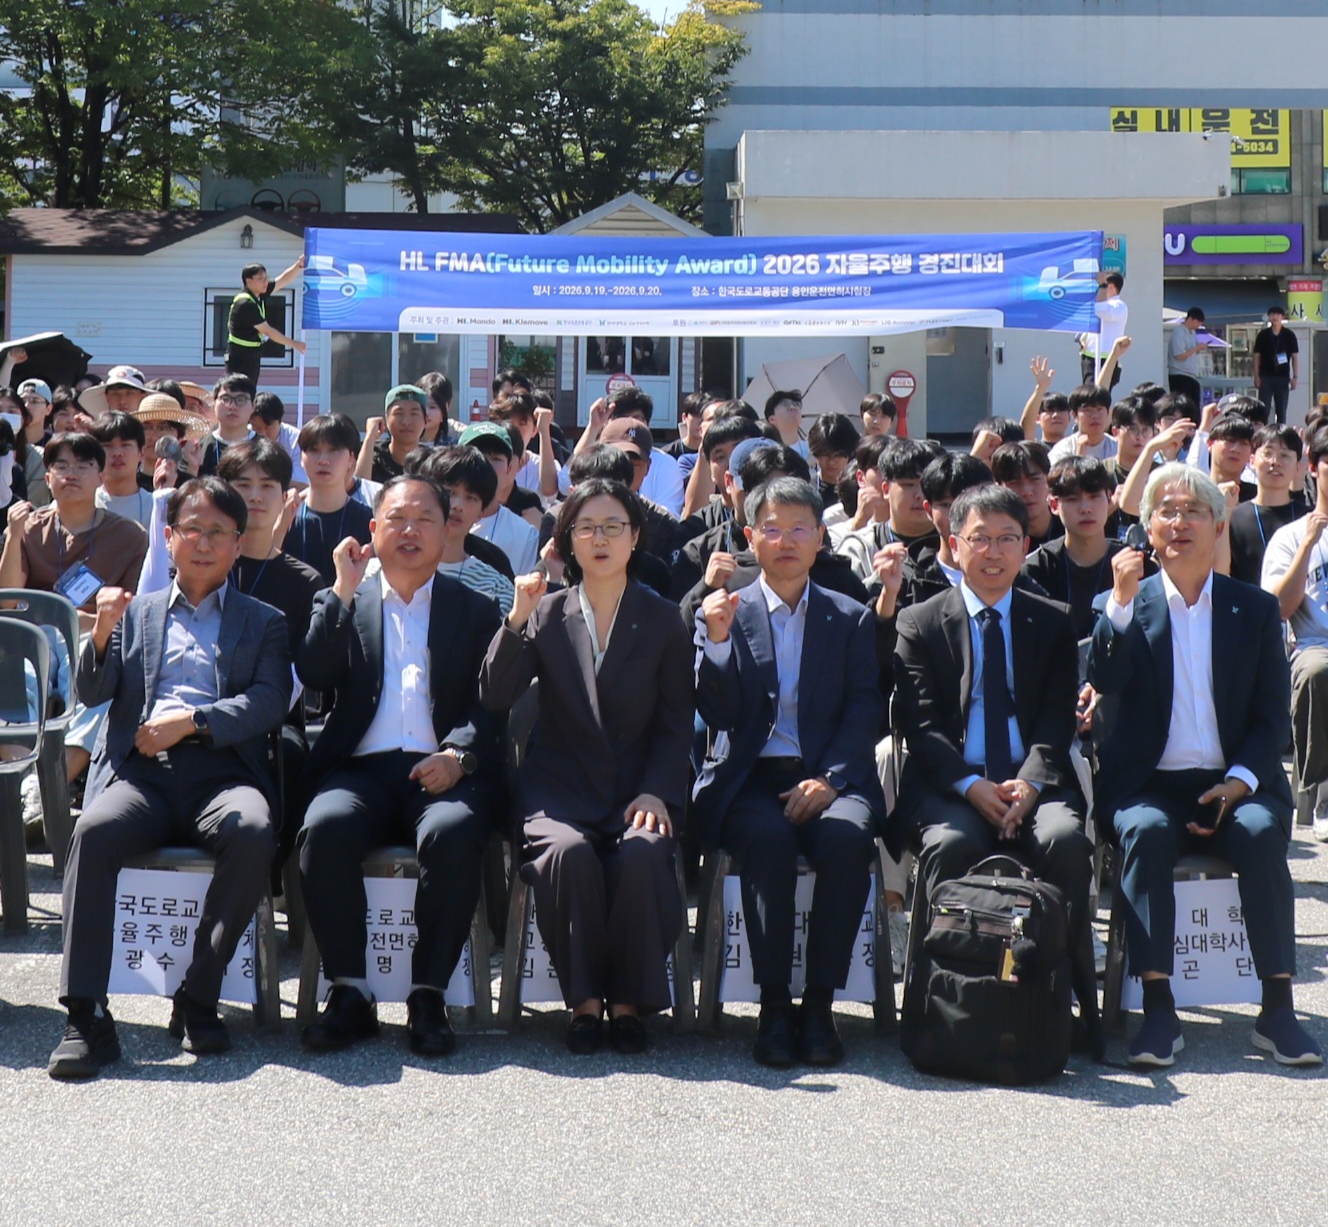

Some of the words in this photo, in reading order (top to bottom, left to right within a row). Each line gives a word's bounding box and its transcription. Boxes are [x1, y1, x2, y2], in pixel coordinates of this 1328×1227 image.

[399, 251, 429, 271] HL
[576, 254, 669, 276] Mobility
[675, 254, 757, 275] Award)
[763, 253, 821, 274] 2026
[825, 253, 912, 275] 자율주행
[918, 252, 1005, 274] 경진대회
[532, 285, 551, 296] 일시
[691, 286, 709, 297] 장소
